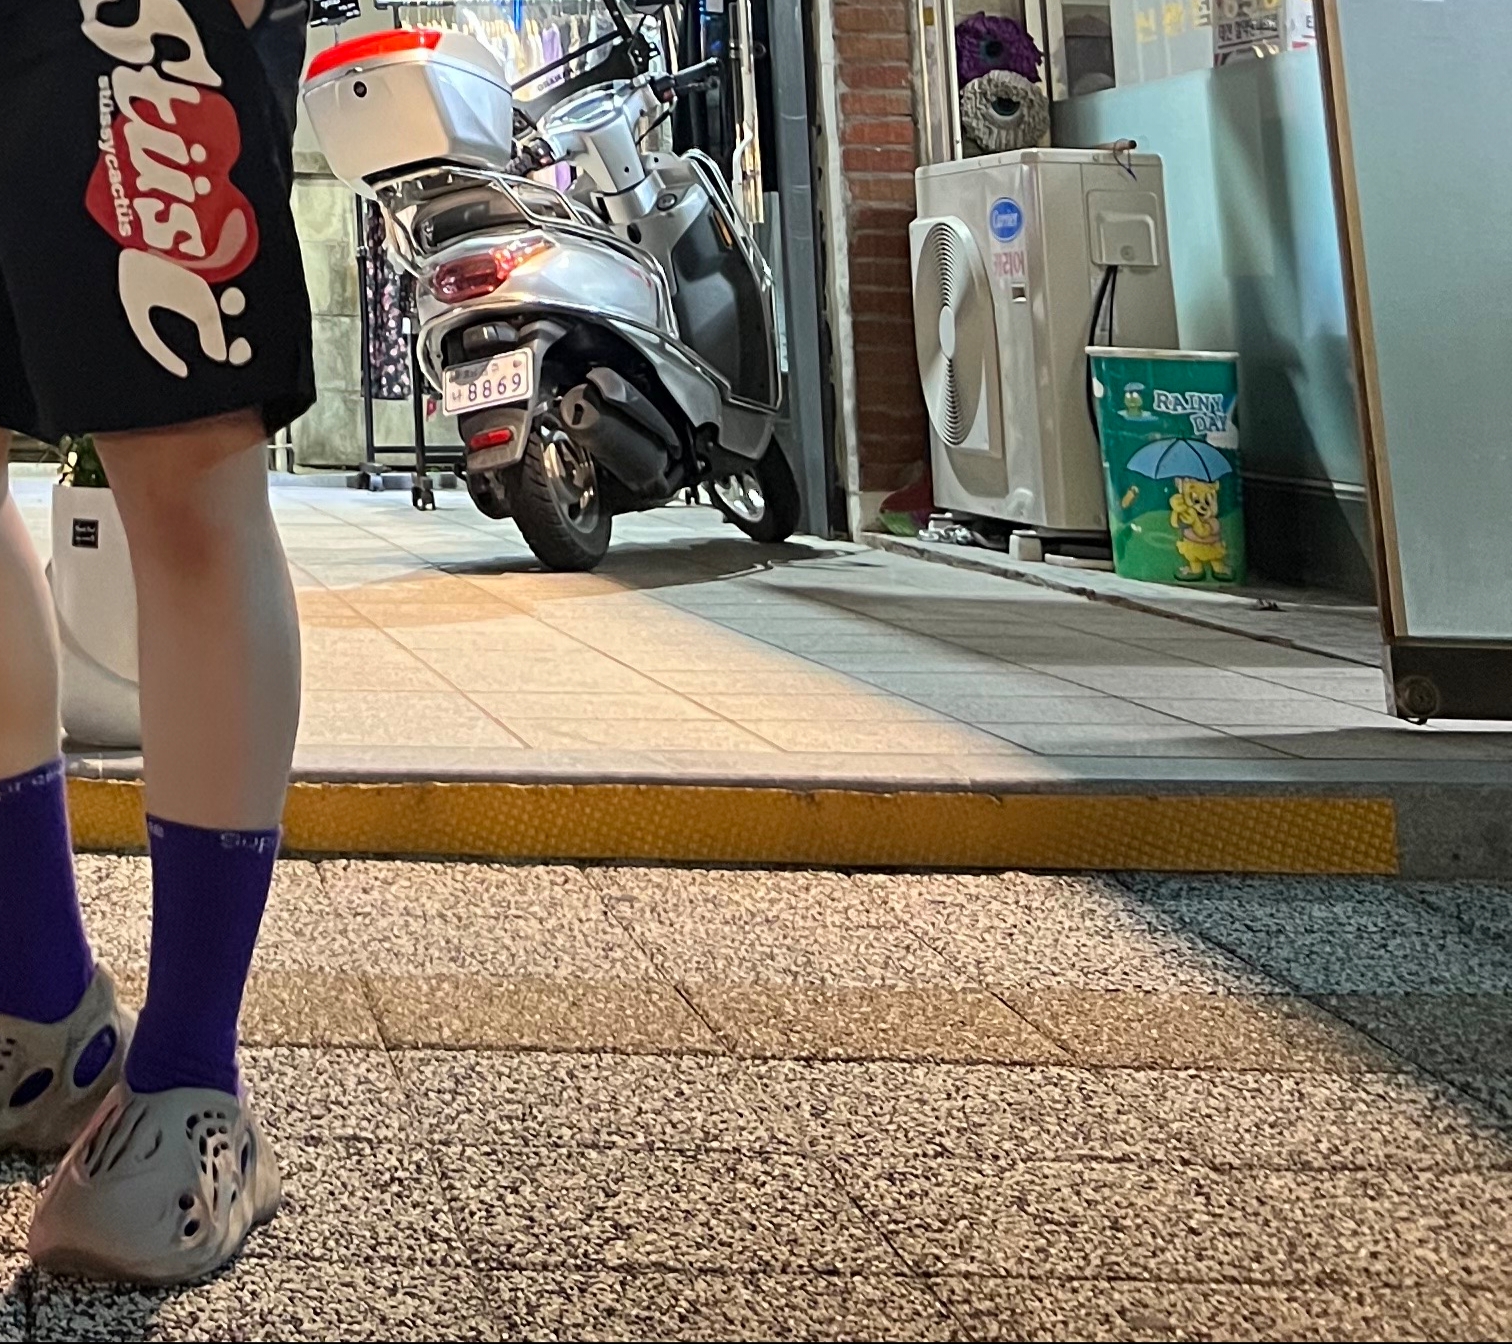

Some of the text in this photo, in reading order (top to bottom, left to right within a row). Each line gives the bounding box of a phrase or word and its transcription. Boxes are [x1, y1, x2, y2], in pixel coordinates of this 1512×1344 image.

[468, 372, 522, 402] 8869
[1153, 389, 1224, 415] RAINY
[1191, 412, 1230, 435] DAY
